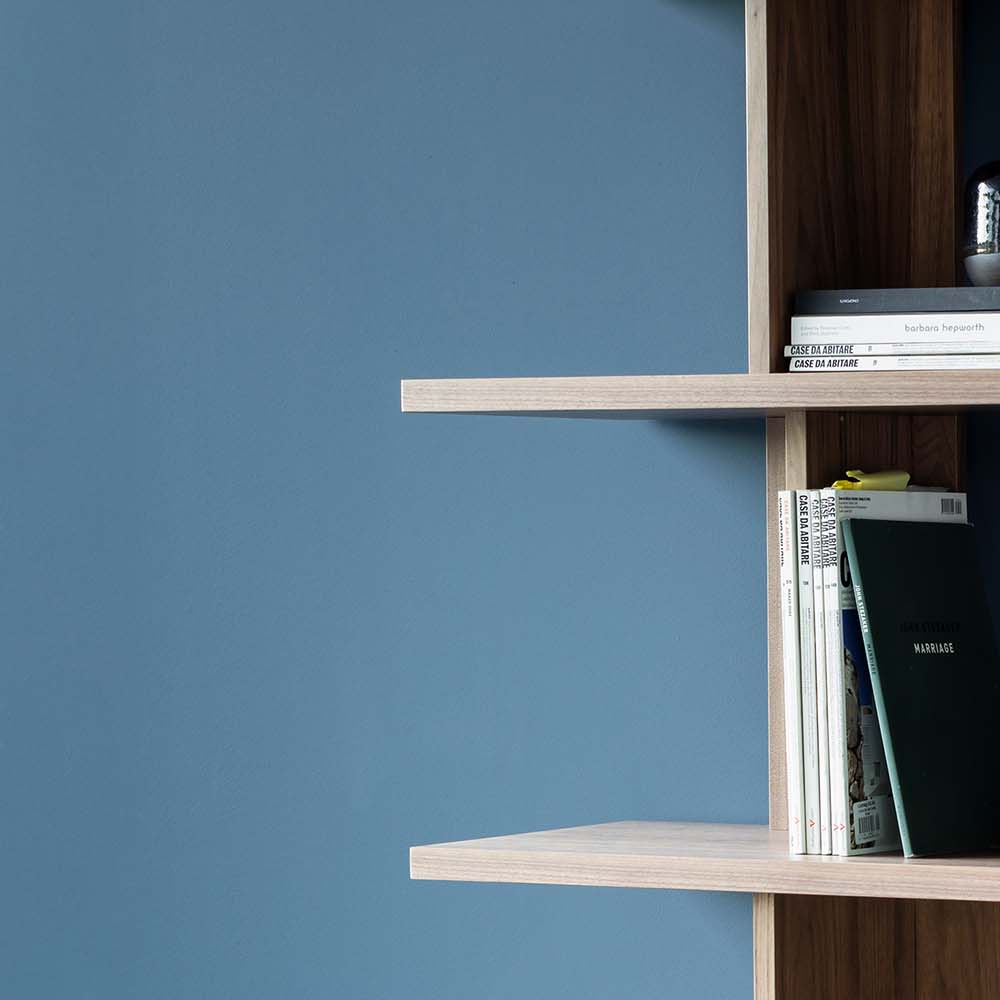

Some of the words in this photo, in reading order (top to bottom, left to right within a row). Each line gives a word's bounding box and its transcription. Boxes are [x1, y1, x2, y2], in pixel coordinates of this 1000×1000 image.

[904, 323, 939, 333] barbara
[942, 322, 985, 334] hepworth
[790, 345, 810, 355] CASE
[811, 345, 822, 355] DA
[822, 345, 855, 355] ABITARE
[794, 359, 814, 369] CASE
[815, 359, 826, 369] DA
[827, 358, 860, 368] ABITARE
[799, 495, 809, 517] CASE
[811, 500, 820, 520] CASE
[827, 496, 836, 518] CASE
[800, 517, 809, 530] DA
[812, 522, 820, 533] DA
[828, 519, 837, 531] DA
[800, 530, 810, 566] ABITARE
[812, 535, 821, 569] ABITARE
[828, 532, 838, 567] ABITARE
[855, 584, 863, 601] JOHN
[913, 642, 956, 655] MARRIAGE
